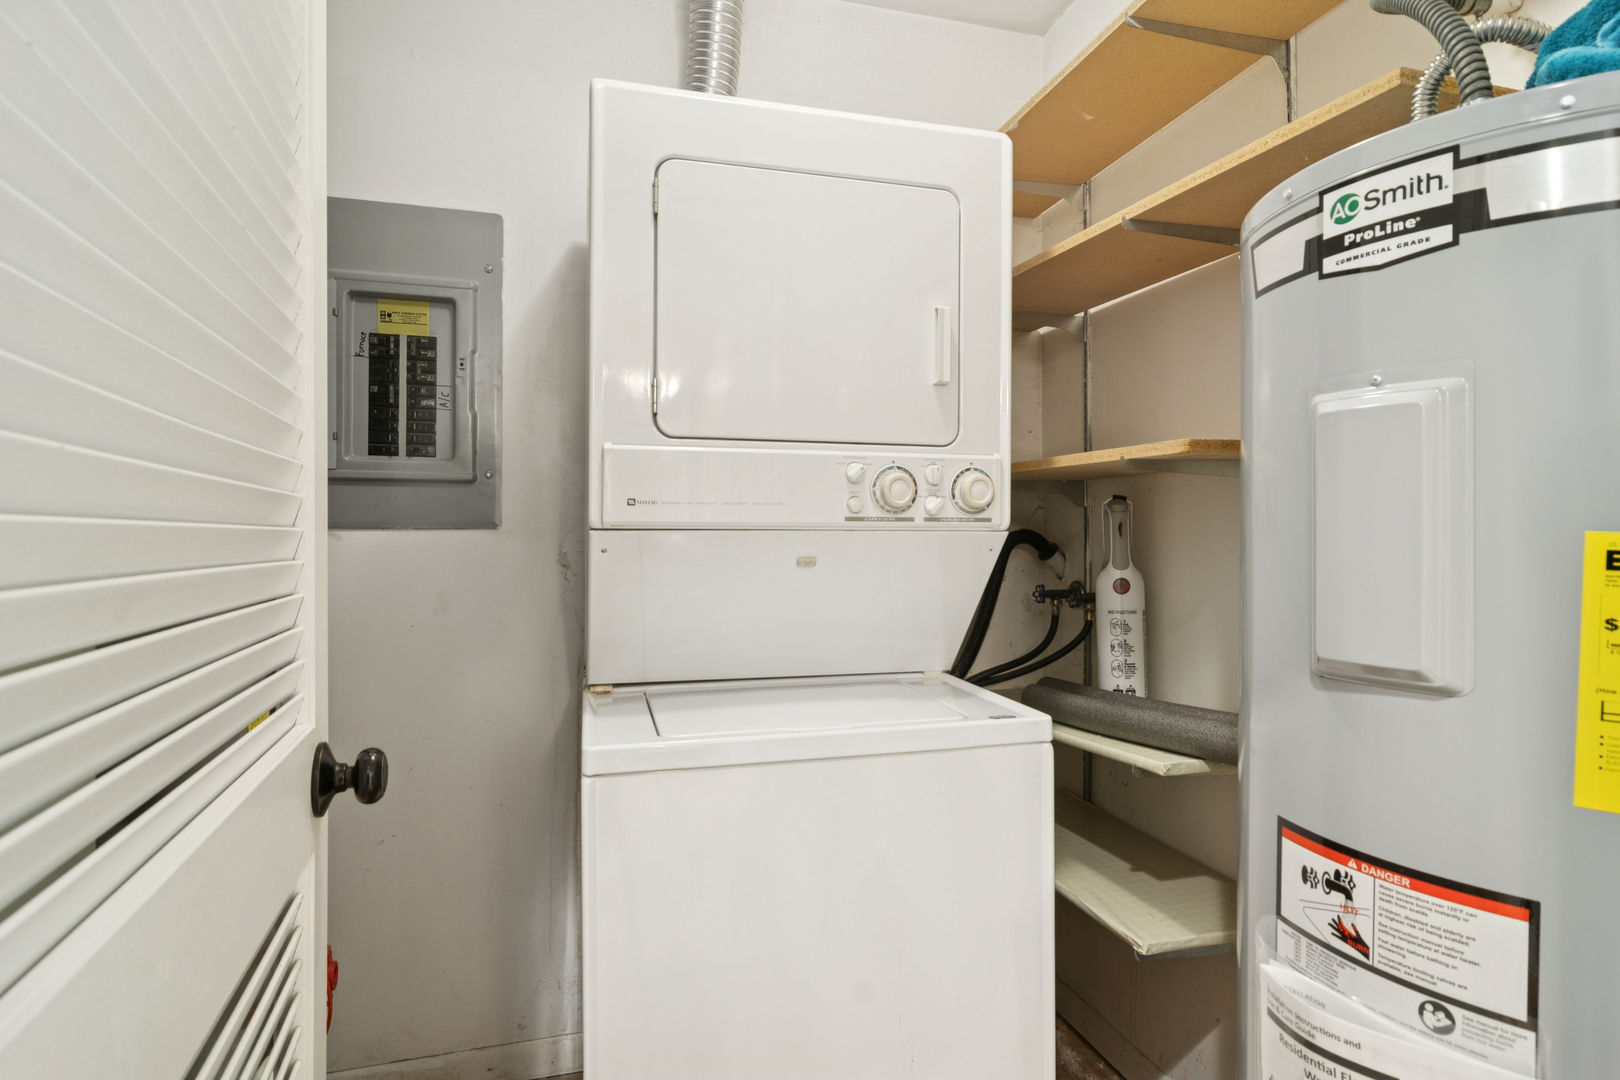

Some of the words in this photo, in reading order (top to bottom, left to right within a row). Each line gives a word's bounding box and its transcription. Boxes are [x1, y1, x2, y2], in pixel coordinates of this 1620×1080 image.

[1332, 196, 1361, 222] AO
[1364, 172, 1443, 211] Smith
[1336, 246, 1392, 266] COMMERCIAL
[1397, 236, 1431, 249] GRADE
[355, 332, 367, 357] Furnace
[439, 392, 450, 408] A/C
[1361, 863, 1410, 888] DANGER
[1379, 884, 1394, 892] Water
[1395, 890, 1429, 904] temperature
[1379, 897, 1393, 905] death
[1395, 901, 1407, 910] from
[1379, 891, 1394, 899] cause
[1396, 897, 1414, 905] severe
[1416, 902, 1432, 912] burns
[1434, 908, 1460, 921] instantly
[1378, 906, 1402, 918] Children,
[1404, 916, 1428, 927] disabled
[1443, 928, 1464, 939] elderly
[1385, 914, 1405, 925] highest
[1426, 930, 1442, 939] being
[1347, 939, 1370, 955] BURN
[1378, 928, 1396, 939] setting
[1398, 936, 1432, 951] temperature
[1441, 950, 1458, 959] water
[1389, 924, 1419, 939] instruction
[1421, 938, 1442, 948] manual
[1444, 945, 1464, 955] before
[1378, 953, 1411, 970] Temperature
[1413, 967, 1434, 979] limiting
[1436, 977, 1456, 986] valves
[1407, 948, 1425, 958] before
[1427, 956, 1449, 968] bathing
[1281, 1009, 1293, 1026] Care
[1295, 1021, 1316, 1040] Guide
[1295, 1012, 1341, 1042] Instructions
[1343, 1038, 1361, 1050] and
[1279, 1033, 1337, 1078] Residential
